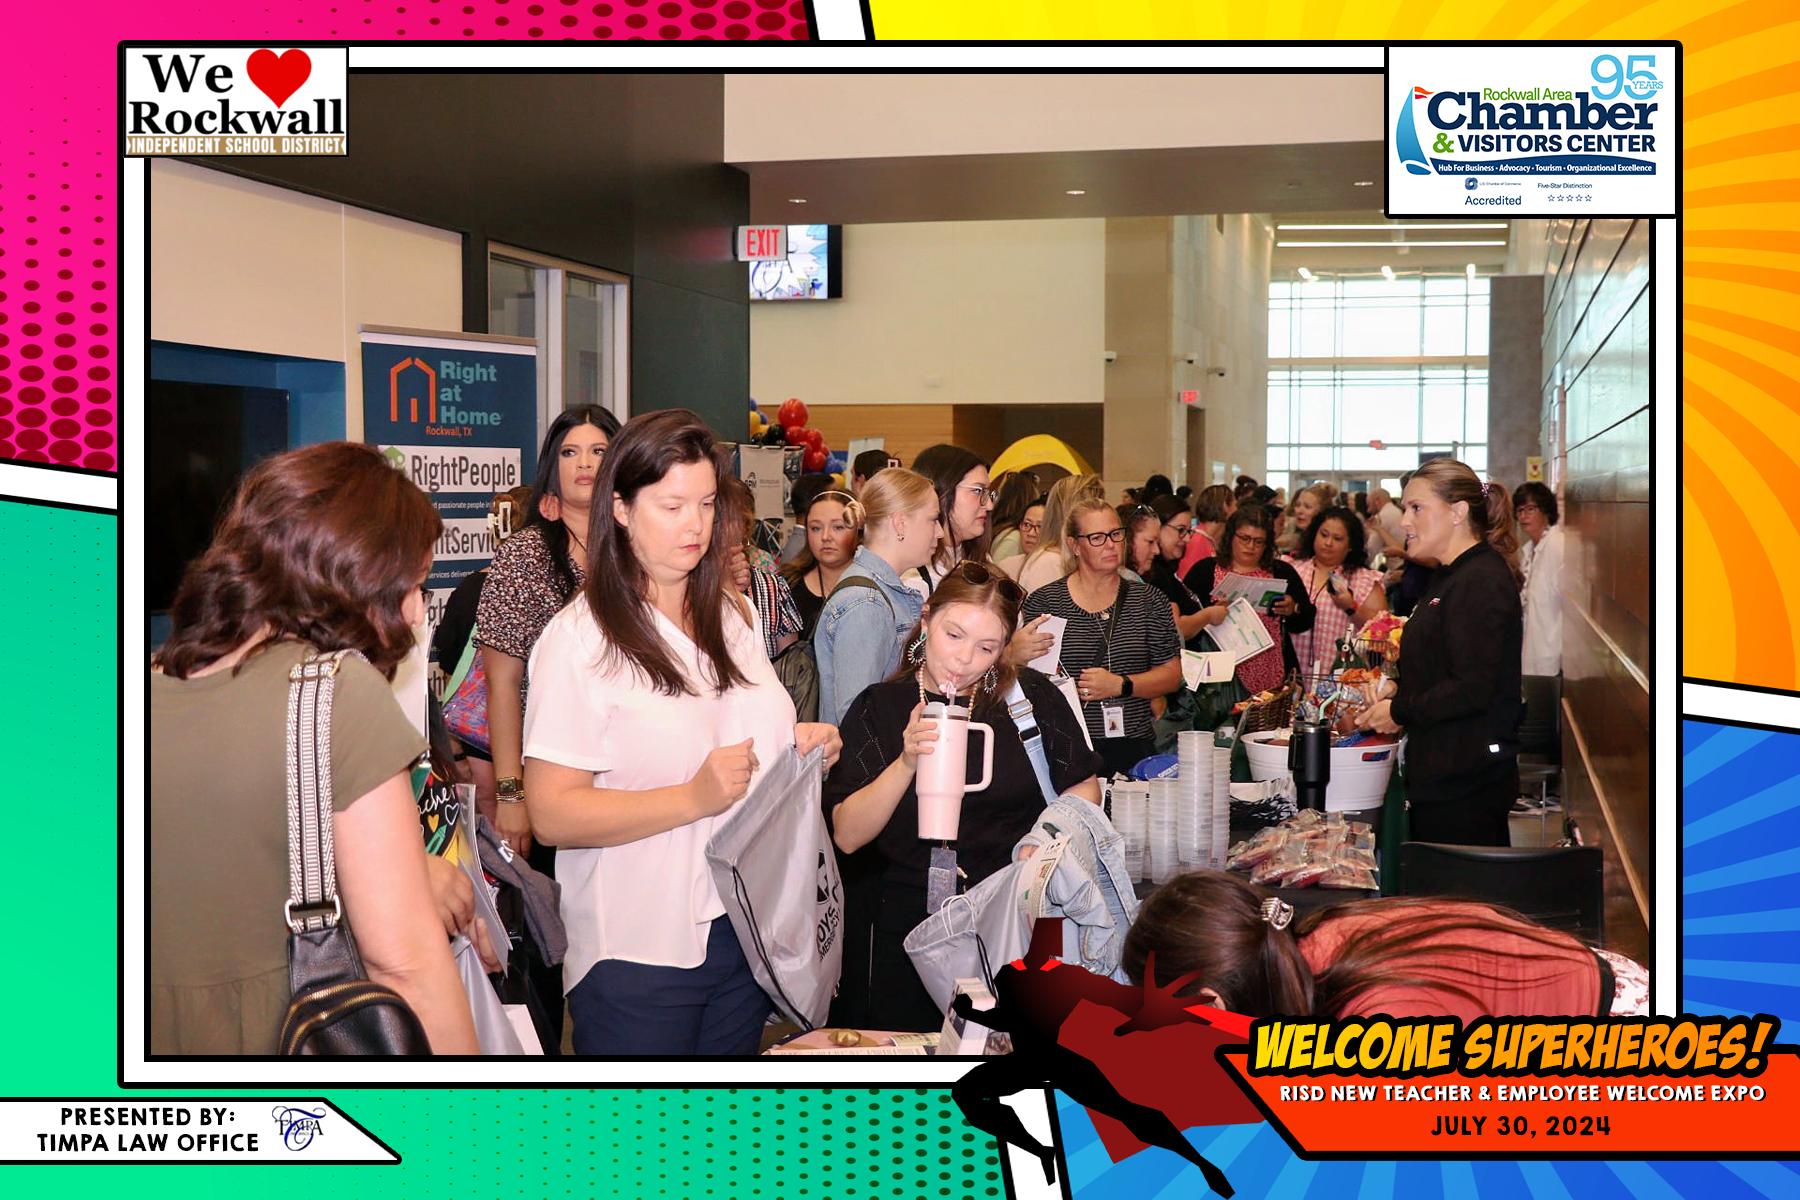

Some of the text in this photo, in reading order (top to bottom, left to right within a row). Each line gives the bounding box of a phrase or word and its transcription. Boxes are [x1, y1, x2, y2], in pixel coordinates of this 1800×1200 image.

[746, 229, 780, 256] EXIT
[440, 360, 497, 384] Right
[440, 385, 462, 402] at
[440, 406, 501, 426] Home
[463, 426, 473, 437] TX
[411, 455, 516, 493] RightPeople
